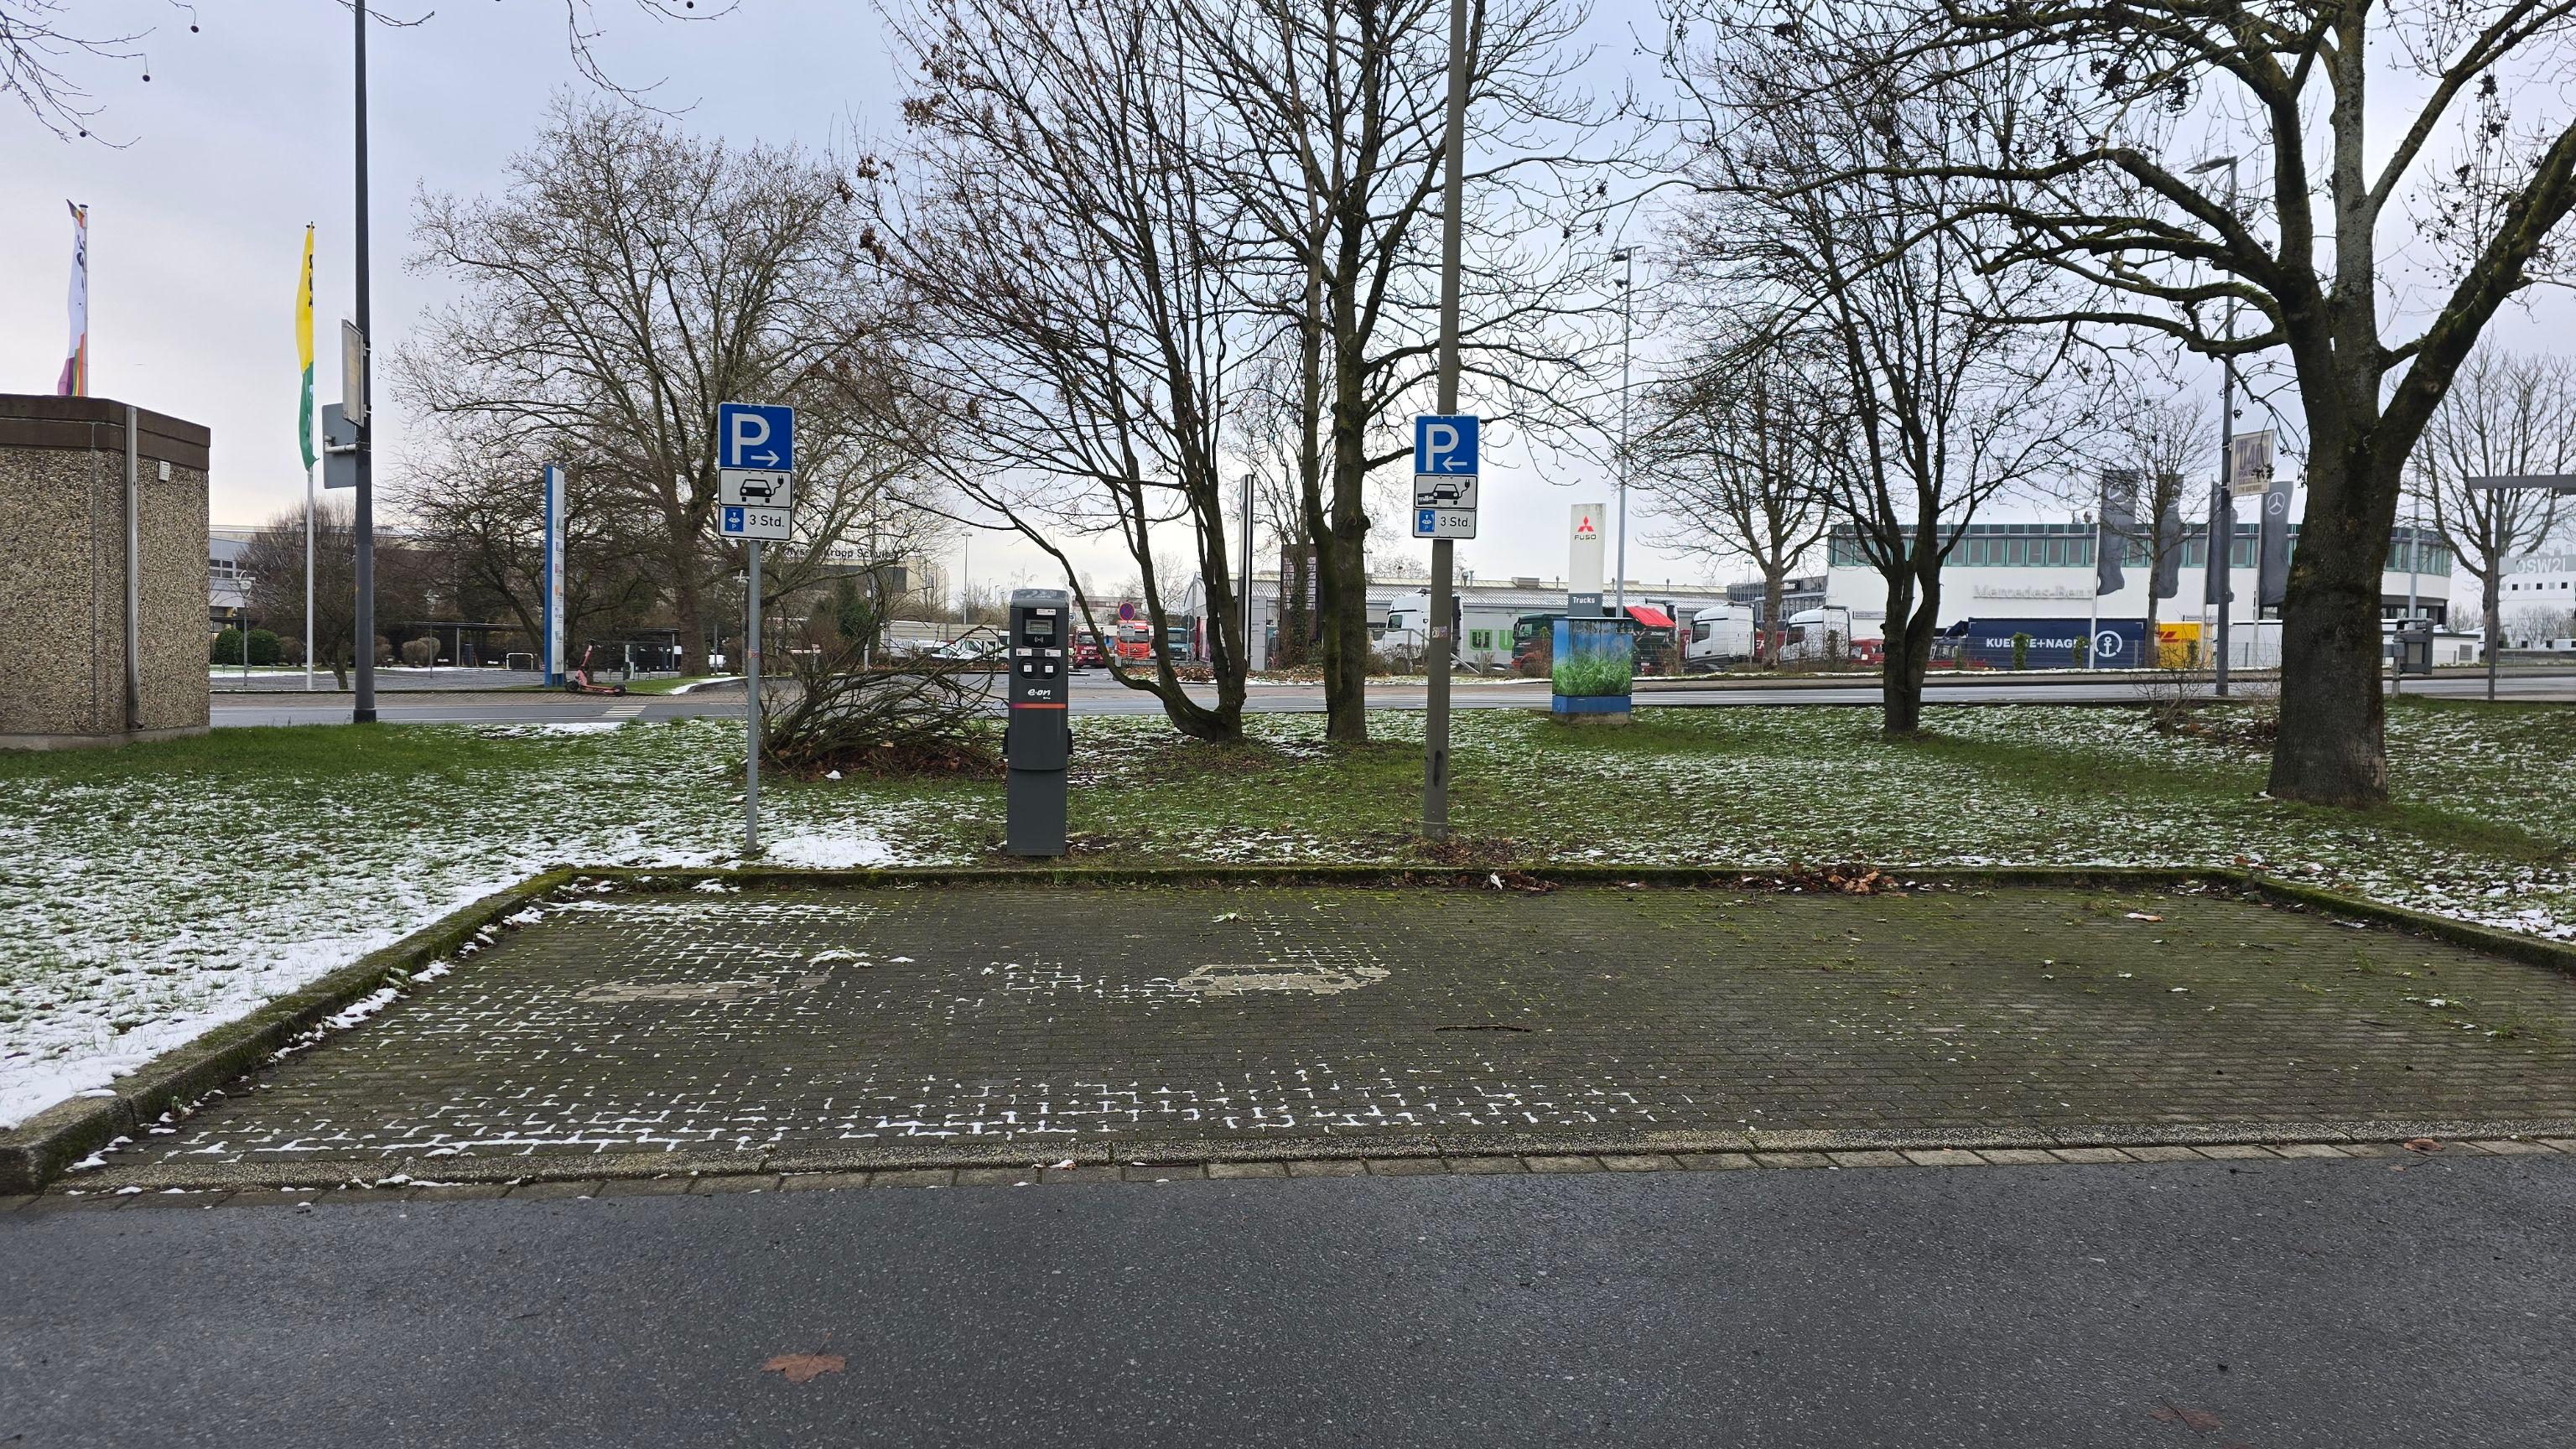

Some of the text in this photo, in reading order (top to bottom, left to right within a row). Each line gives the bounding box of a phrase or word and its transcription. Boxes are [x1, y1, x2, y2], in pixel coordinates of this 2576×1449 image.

[732, 413, 770, 465] P
[1426, 424, 1459, 471] P
[749, 514, 785, 527] 3 Std.
[1440, 517, 1471, 527] 3 Std.
